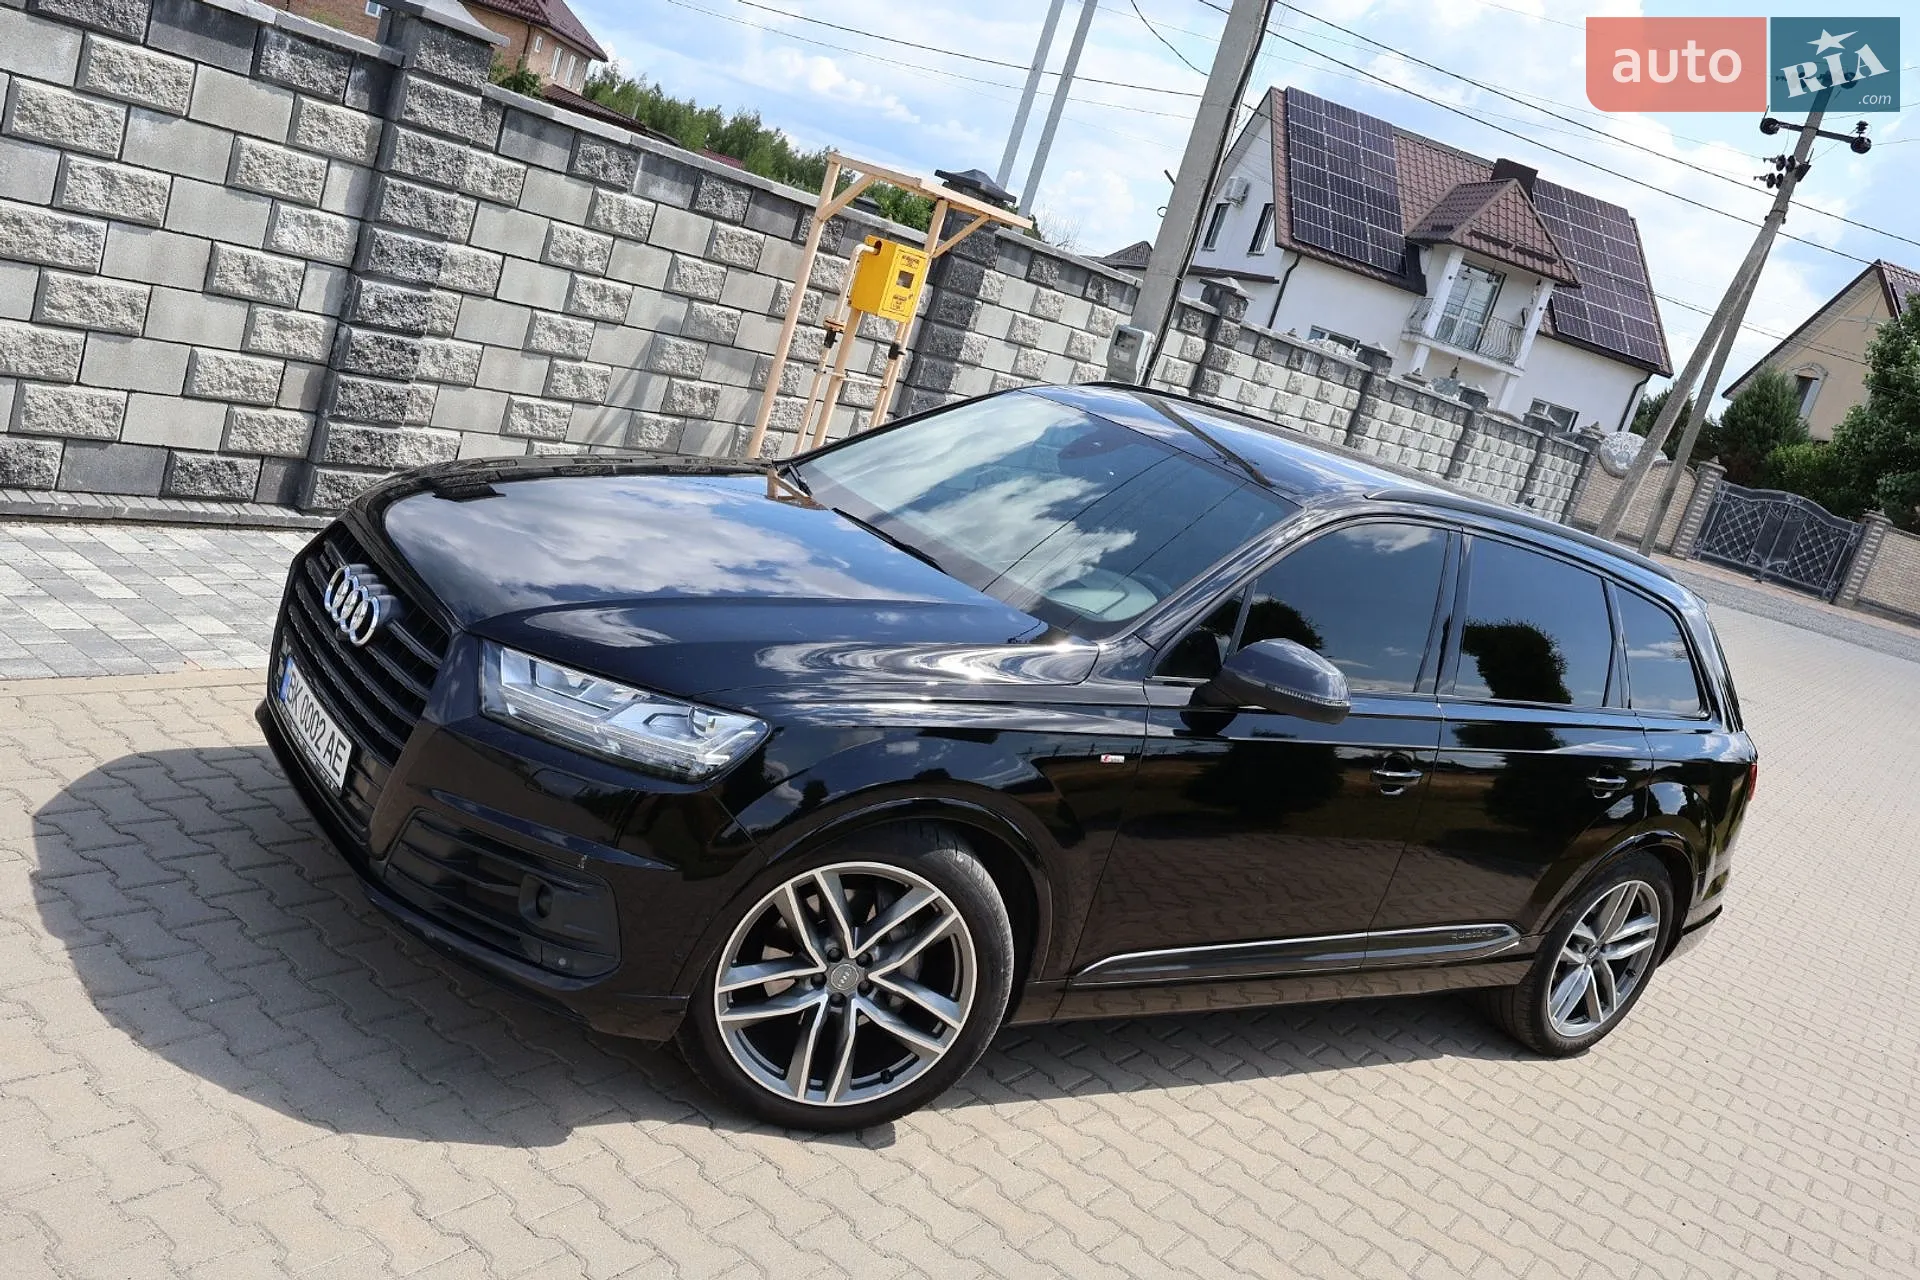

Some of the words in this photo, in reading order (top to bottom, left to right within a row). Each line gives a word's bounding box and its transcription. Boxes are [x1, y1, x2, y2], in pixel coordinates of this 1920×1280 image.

[287, 672, 303, 717] BK
[299, 694, 326, 752] 0002
[323, 731, 346, 777] AE
